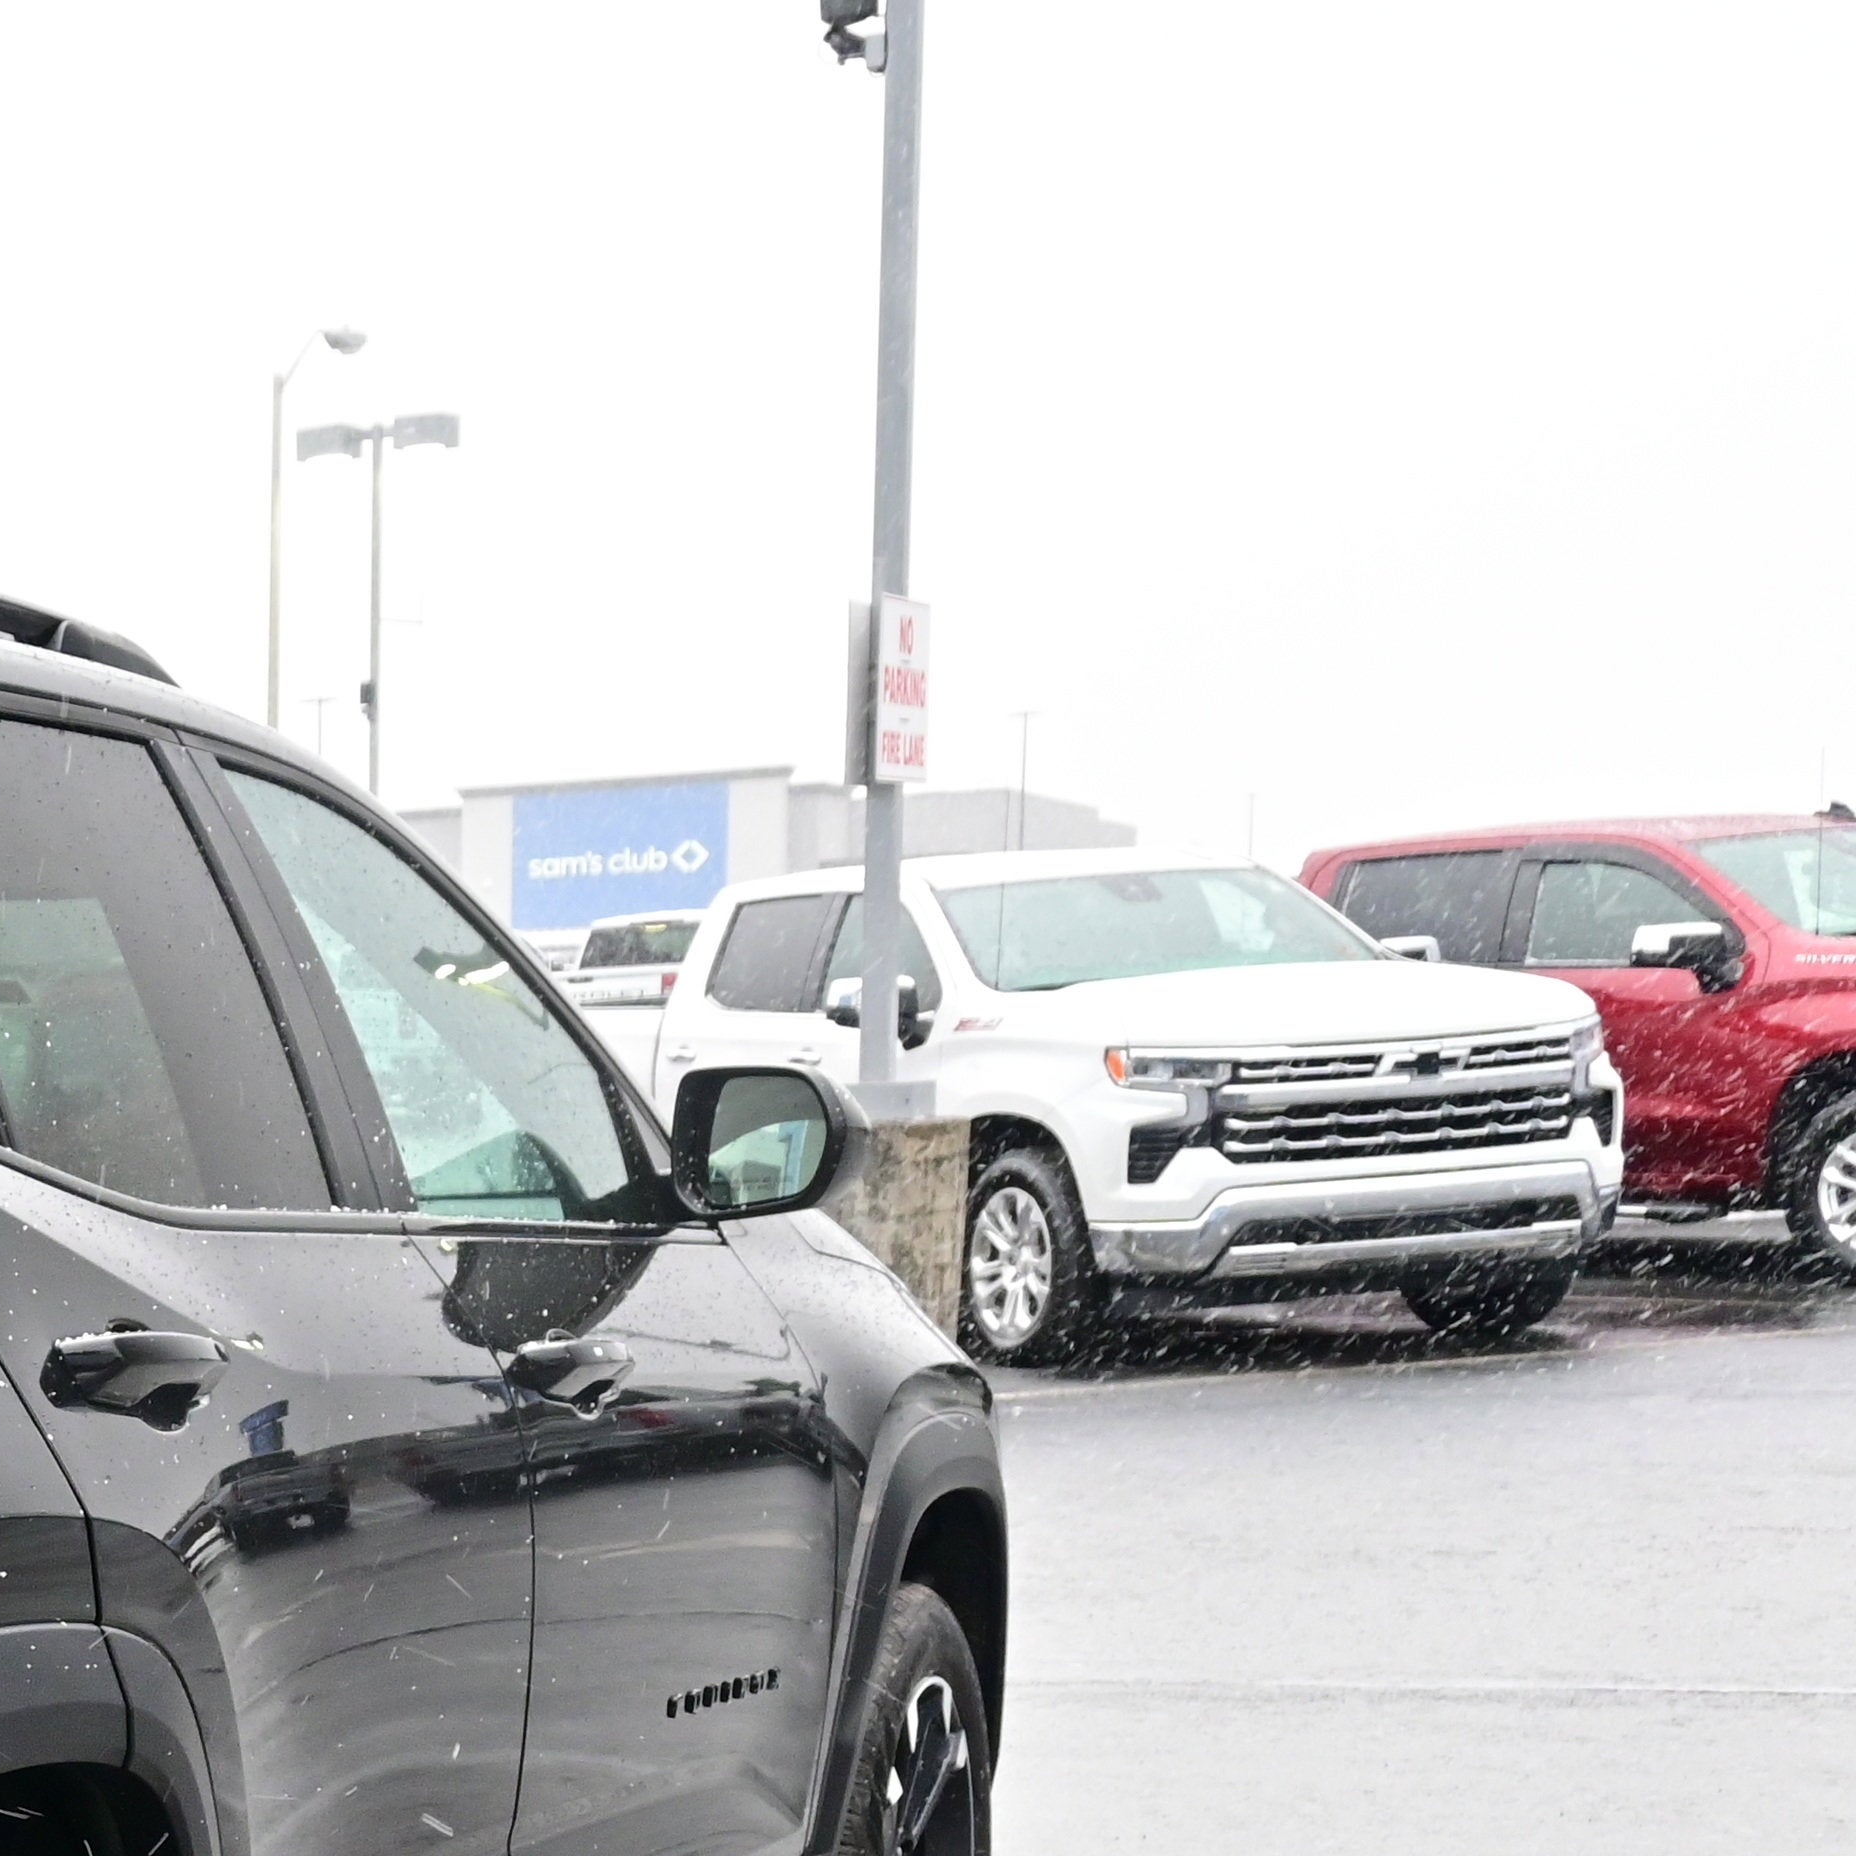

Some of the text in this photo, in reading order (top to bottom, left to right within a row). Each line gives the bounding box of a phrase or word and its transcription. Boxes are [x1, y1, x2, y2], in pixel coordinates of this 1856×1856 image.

[899, 616, 914, 656] NO
[884, 665, 926, 708] PARKING
[882, 730, 925, 766] FIRE LANE
[529, 845, 668, 879] sam's club
